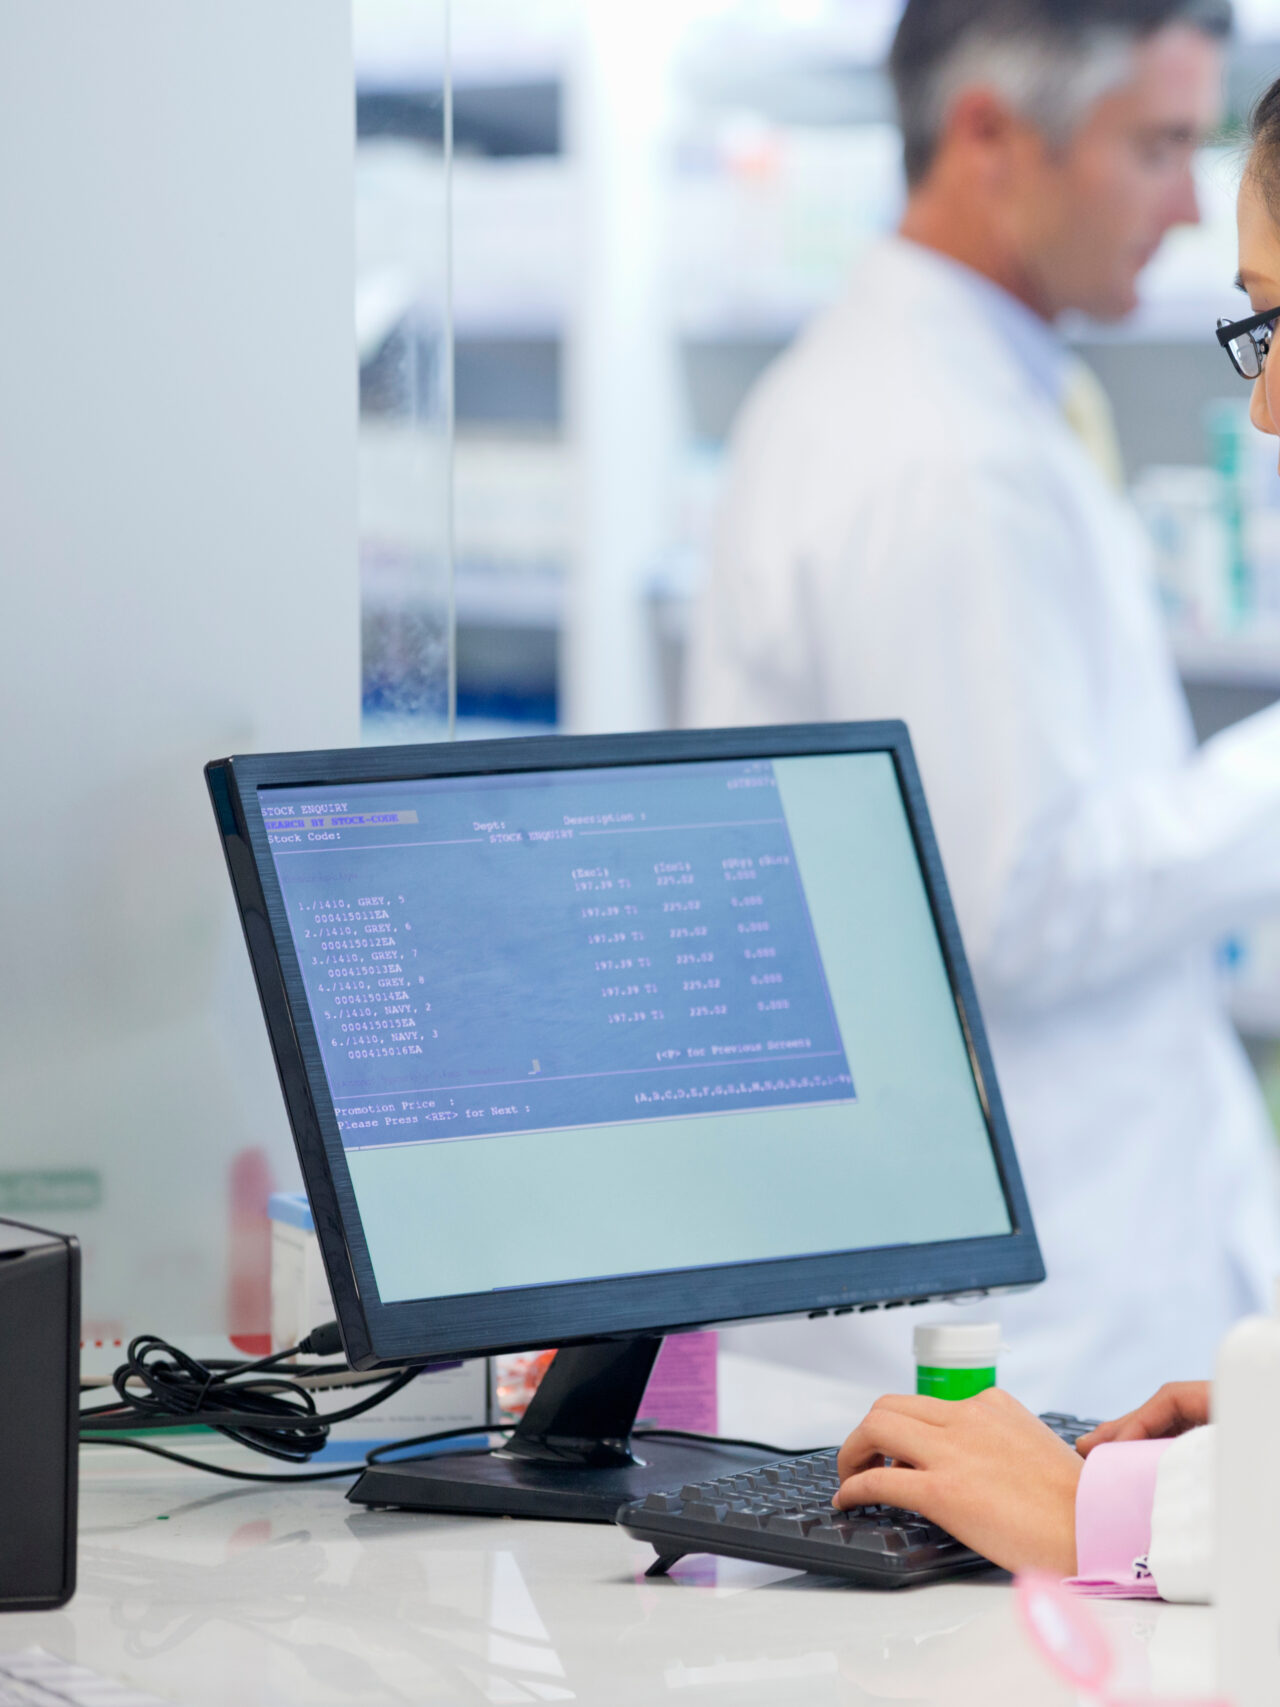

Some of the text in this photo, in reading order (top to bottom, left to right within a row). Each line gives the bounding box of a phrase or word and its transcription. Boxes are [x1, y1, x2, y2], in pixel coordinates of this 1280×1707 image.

[261, 803, 348, 817] STOCK ENQUIRY
[264, 814, 399, 830] SEARCH BY STOCK-CODE
[473, 821, 505, 833] Dept:
[563, 813, 634, 826] Description
[268, 831, 342, 844] Stock Code:
[489, 830, 574, 844] STOCK ENQUIRY
[298, 895, 405, 911] 1./1410, GREY, 5
[314, 910, 390, 923] 000415011EA
[304, 922, 412, 938] 2./1410, GREY, 6
[321, 937, 396, 951] 000415012EA
[312, 949, 418, 965] 3./1410, GREY, 7
[328, 964, 402, 978] 000415013EA
[318, 976, 425, 992] 4./1410, GREY, 8
[334, 991, 410, 1005] 000415014EA
[324, 1002, 432, 1019] 5./1410, NAVY, 2
[341, 1018, 416, 1032] 000415015EA
[331, 1029, 439, 1047] 6./1410, NAVY, 3
[348, 1045, 423, 1060] 000415016EA
[687, 1047, 706, 1058] for
[711, 1042, 762, 1056] Previous
[334, 1103, 396, 1117] Promotion
[402, 1099, 436, 1111] Price
[337, 1118, 379, 1130] Please
[384, 1114, 419, 1126] Press
[425, 1111, 459, 1122] <RET>
[465, 1108, 485, 1118] for
[491, 1105, 519, 1116] Next
